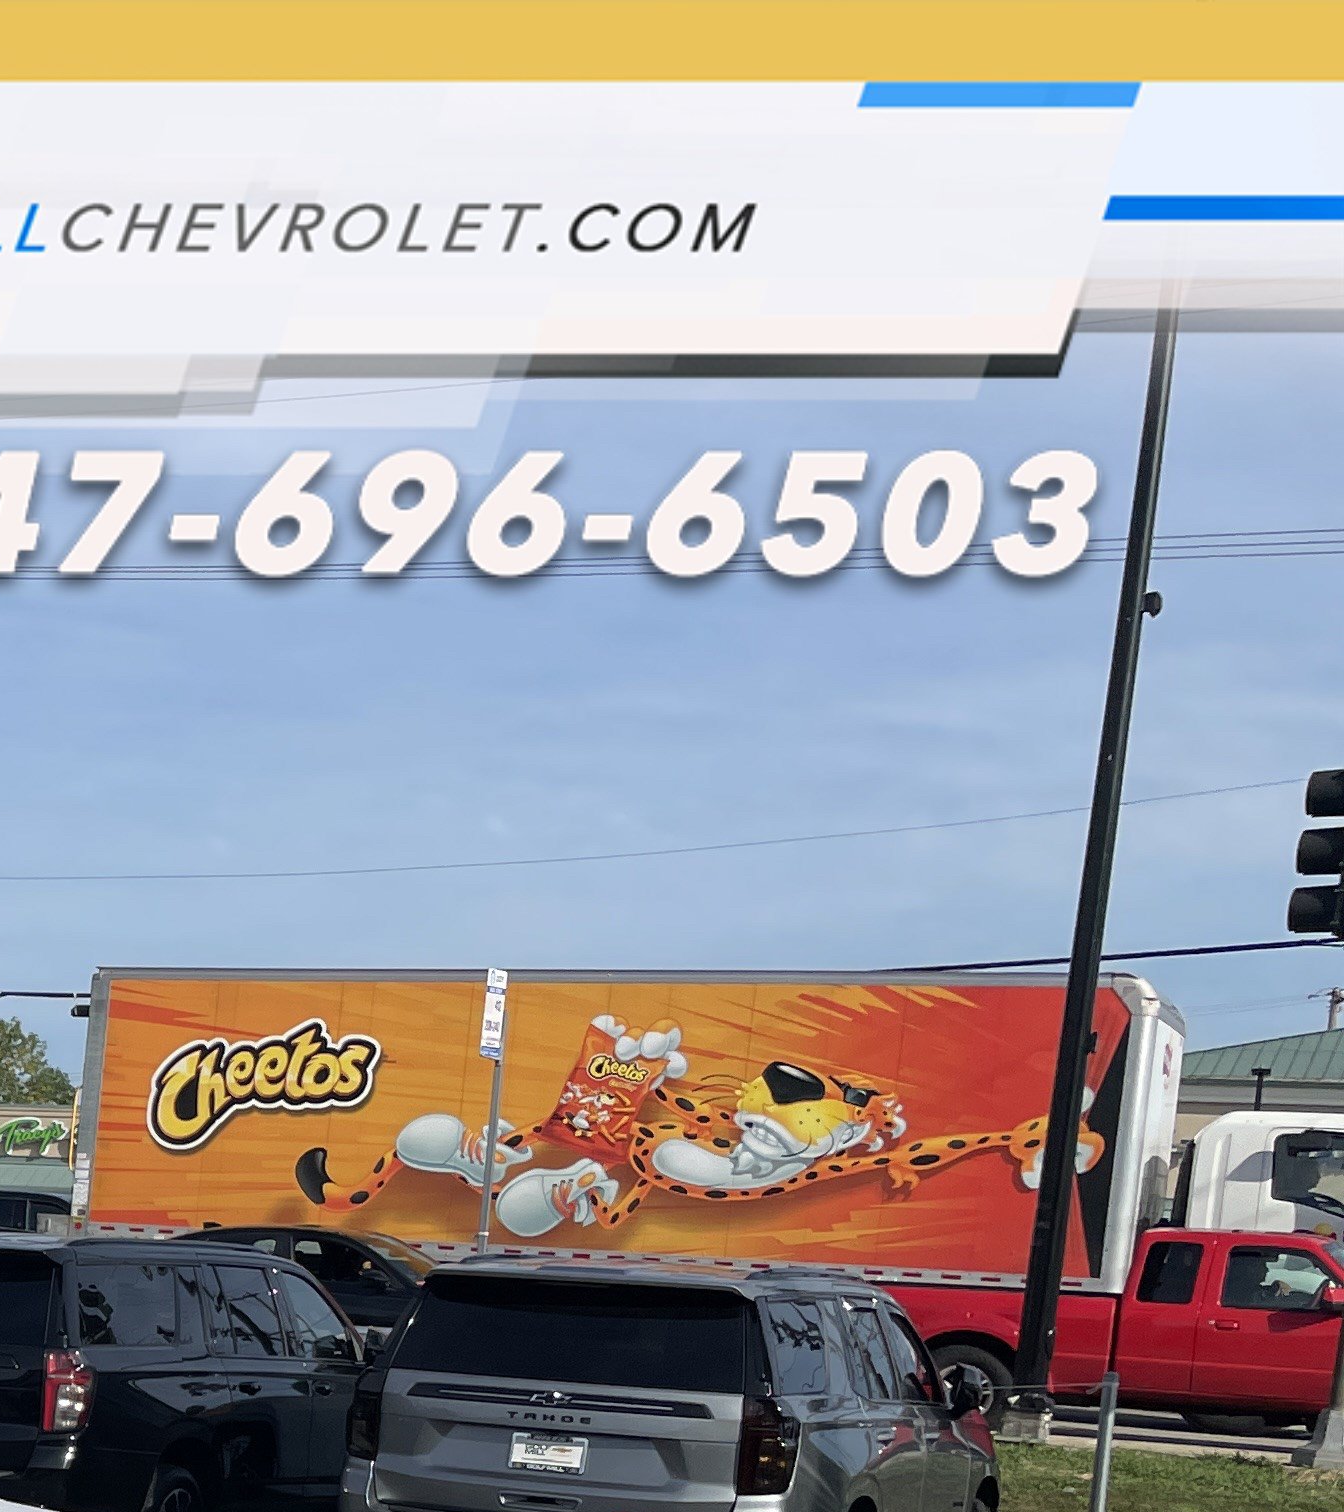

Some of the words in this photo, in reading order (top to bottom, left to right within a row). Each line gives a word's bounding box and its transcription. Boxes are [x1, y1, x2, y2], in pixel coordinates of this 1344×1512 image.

[588, 1054, 649, 1082] Cheetos
[155, 1027, 373, 1140] Cheetos
[507, 1411, 591, 1425] TAHOE
